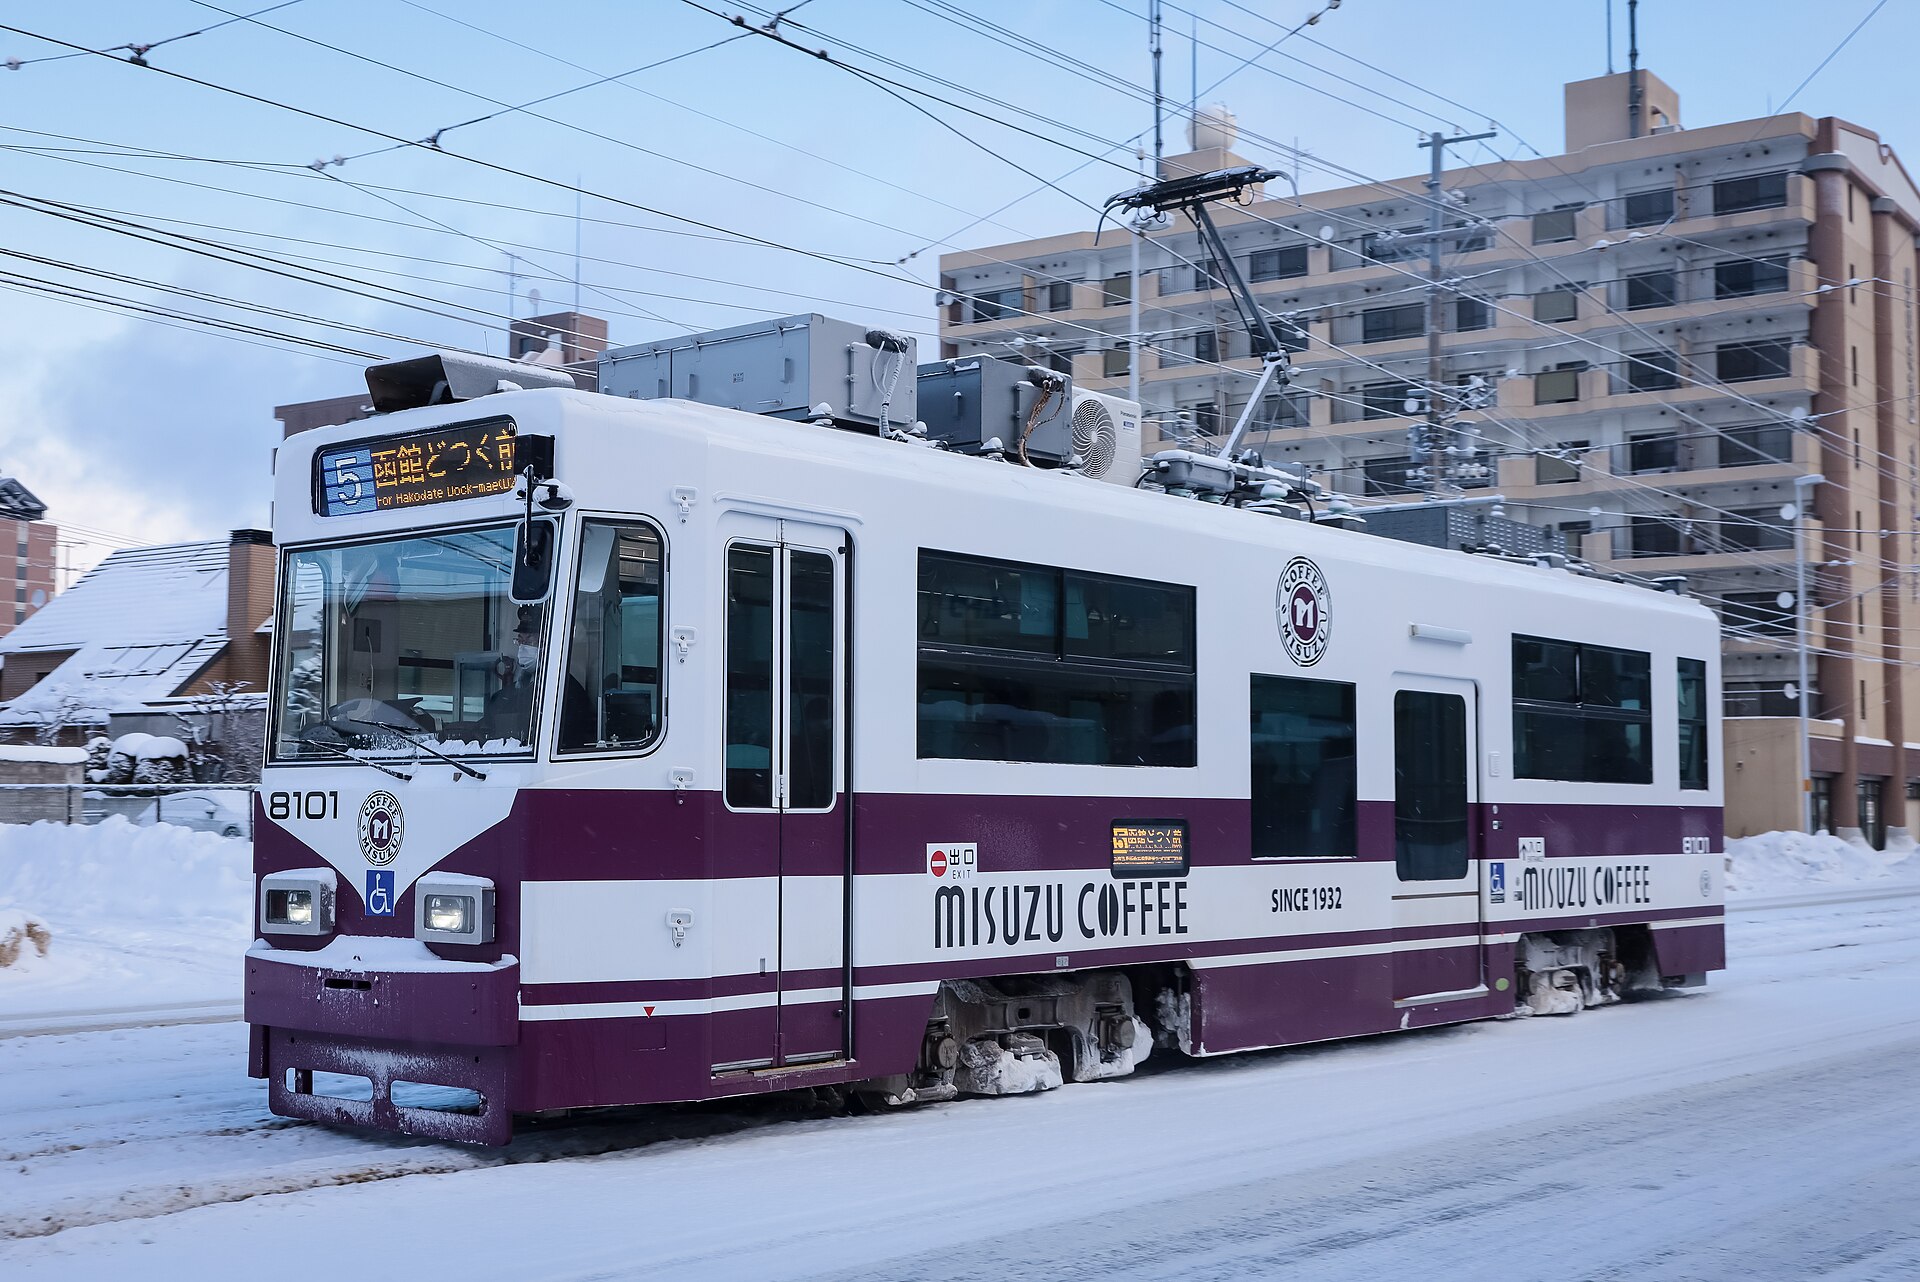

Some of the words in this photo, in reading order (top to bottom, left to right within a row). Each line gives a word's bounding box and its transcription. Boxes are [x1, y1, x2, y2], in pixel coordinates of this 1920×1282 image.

[334, 456, 362, 506] 5
[396, 487, 444, 504] Hakodate
[1284, 565, 1326, 600] COFFEE
[1282, 622, 1326, 659] MISUZU
[269, 790, 339, 820] 8101
[364, 796, 400, 819] COFFEE
[361, 837, 400, 861] MISUZU
[949, 848, 974, 866] 出口
[1683, 836, 1711, 854] 8101
[952, 869, 971, 880] EXIT
[1523, 866, 1587, 911] MISUZU
[1593, 865, 1650, 906] COFFEE
[1271, 887, 1309, 913] SINCE
[1312, 886, 1342, 911] 1932
[934, 884, 1064, 949] MISUZU
[1077, 881, 1188, 939] COFFEE
